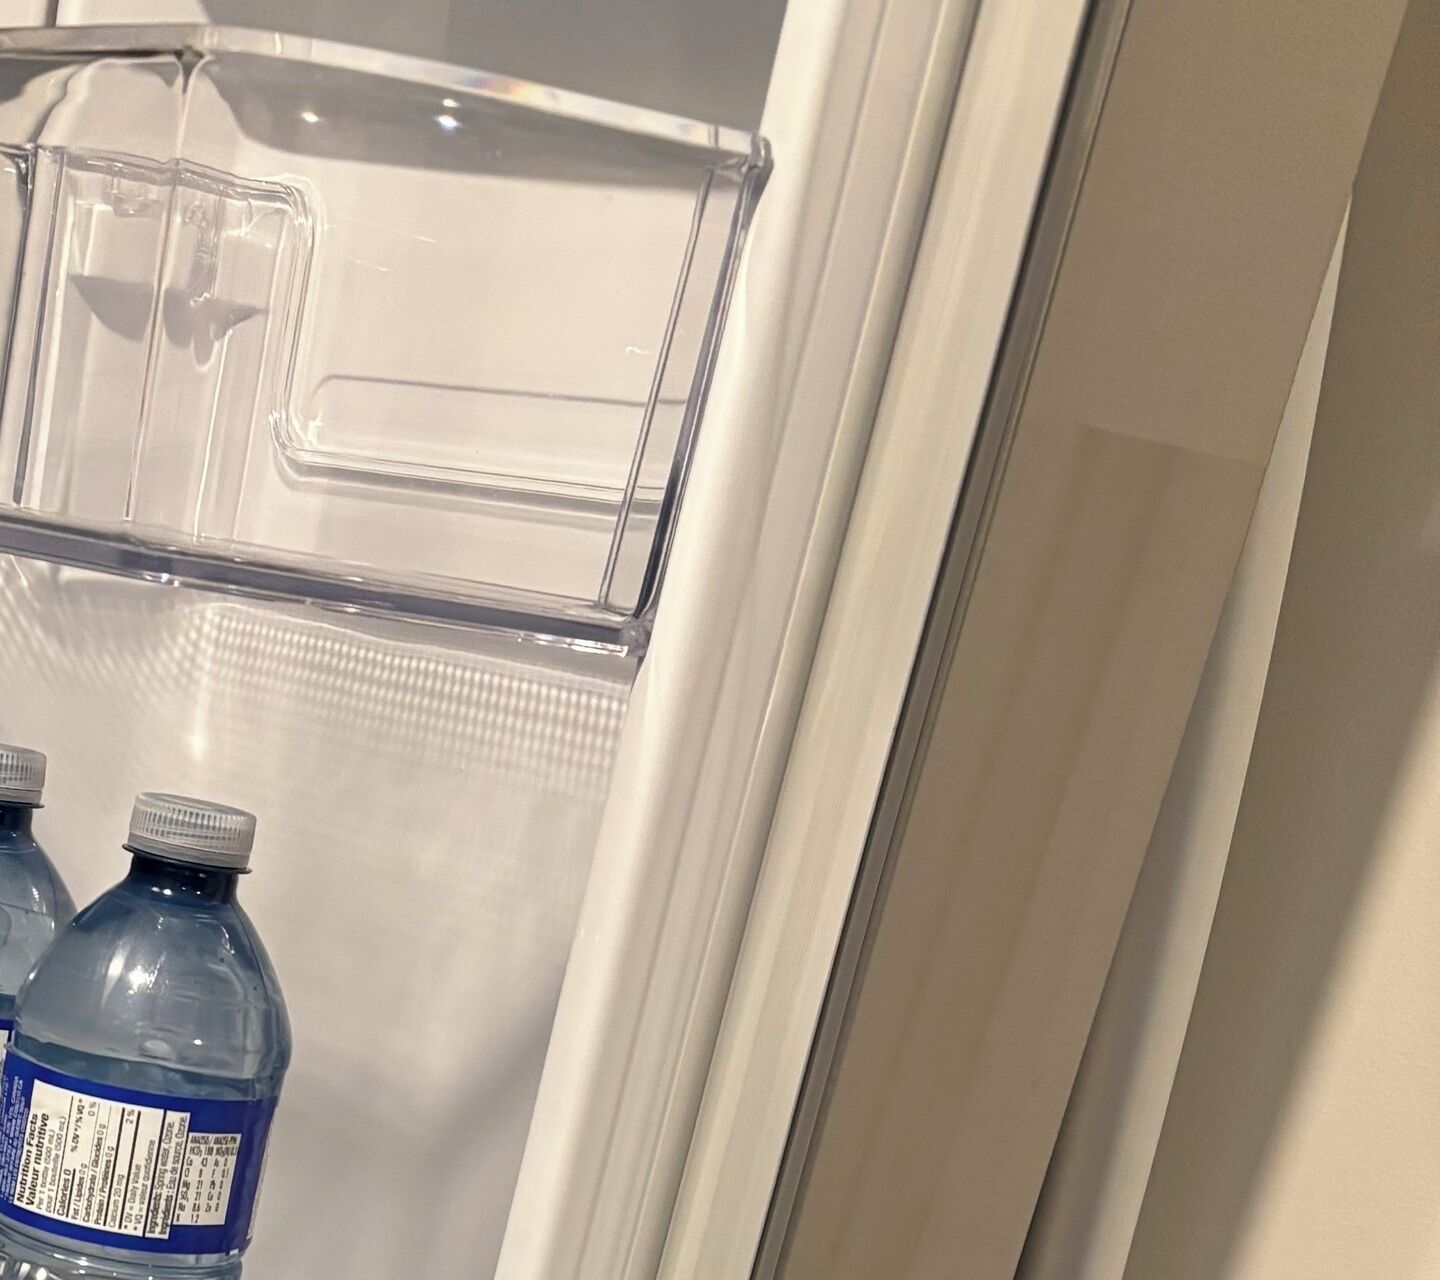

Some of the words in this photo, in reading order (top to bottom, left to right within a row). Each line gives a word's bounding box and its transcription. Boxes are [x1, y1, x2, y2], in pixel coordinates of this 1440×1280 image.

[32, 1112, 49, 1165] nutritive
[16, 1148, 32, 1203] Nutrition
[25, 1112, 38, 1147] Facts
[140, 1138, 155, 1182] quotidienne
[25, 1166, 40, 1206] Valeur
[82, 1173, 98, 1223] Carbohydrate
[91, 1136, 103, 1168] Glucides
[130, 1163, 141, 1185] Value
[154, 1167, 168, 1191] Spring
[165, 1175, 177, 1190] Eau
[56, 1177, 70, 1216] Calories
[73, 1175, 85, 1202] Lipides
[127, 1185, 139, 1204] Daily
[138, 1182, 148, 1206] valeur
[35, 1196, 44, 1210] Per
[44, 1194, 54, 1213] pour
[70, 1207, 79, 1220] Fat
[93, 1198, 104, 1225] Protein
[107, 1198, 119, 1227] Calcium
